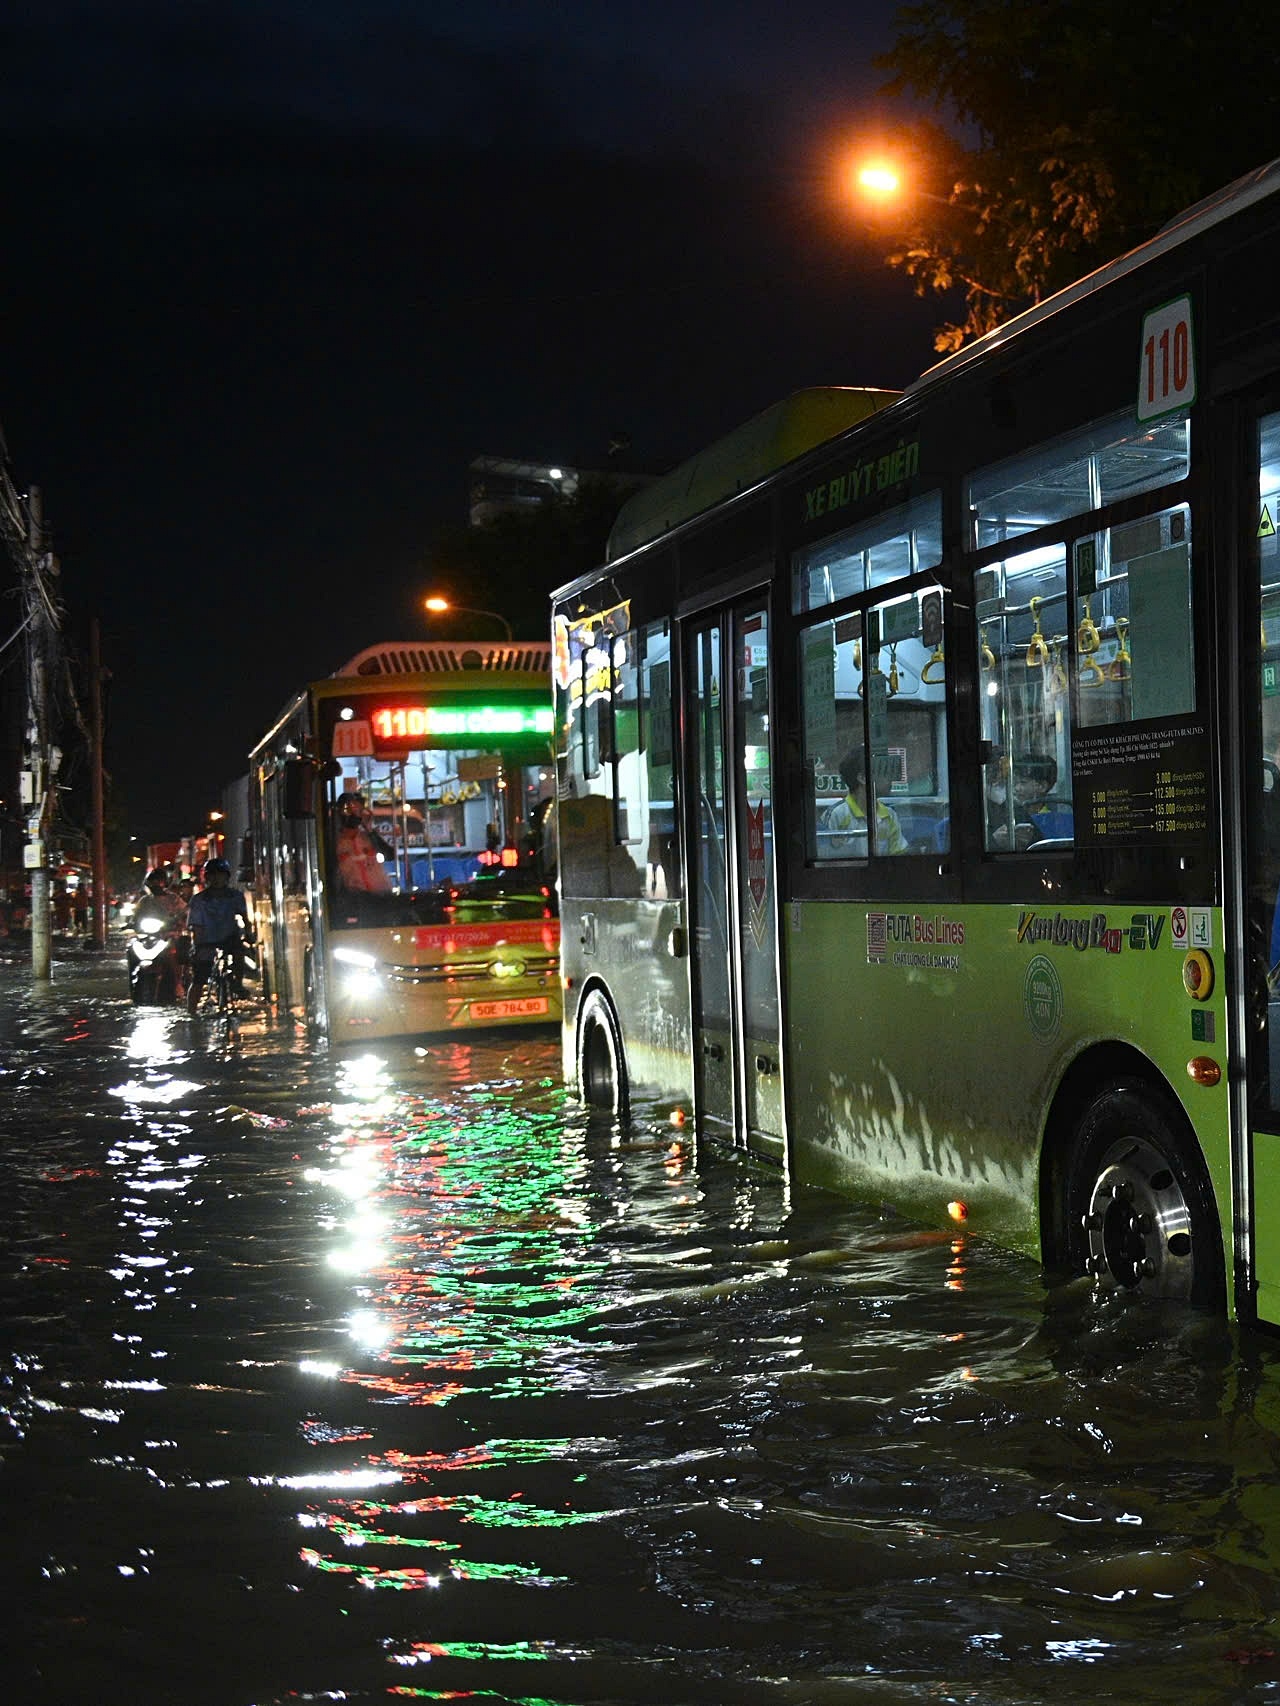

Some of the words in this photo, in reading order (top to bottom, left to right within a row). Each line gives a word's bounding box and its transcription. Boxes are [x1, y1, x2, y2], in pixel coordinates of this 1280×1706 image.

[1145, 320, 1188, 404] 110
[804, 483, 827, 523] XE
[379, 709, 427, 738] 110
[886, 915, 913, 943] FUTA
[914, 915, 934, 945] Bus
[935, 915, 965, 945] Lines
